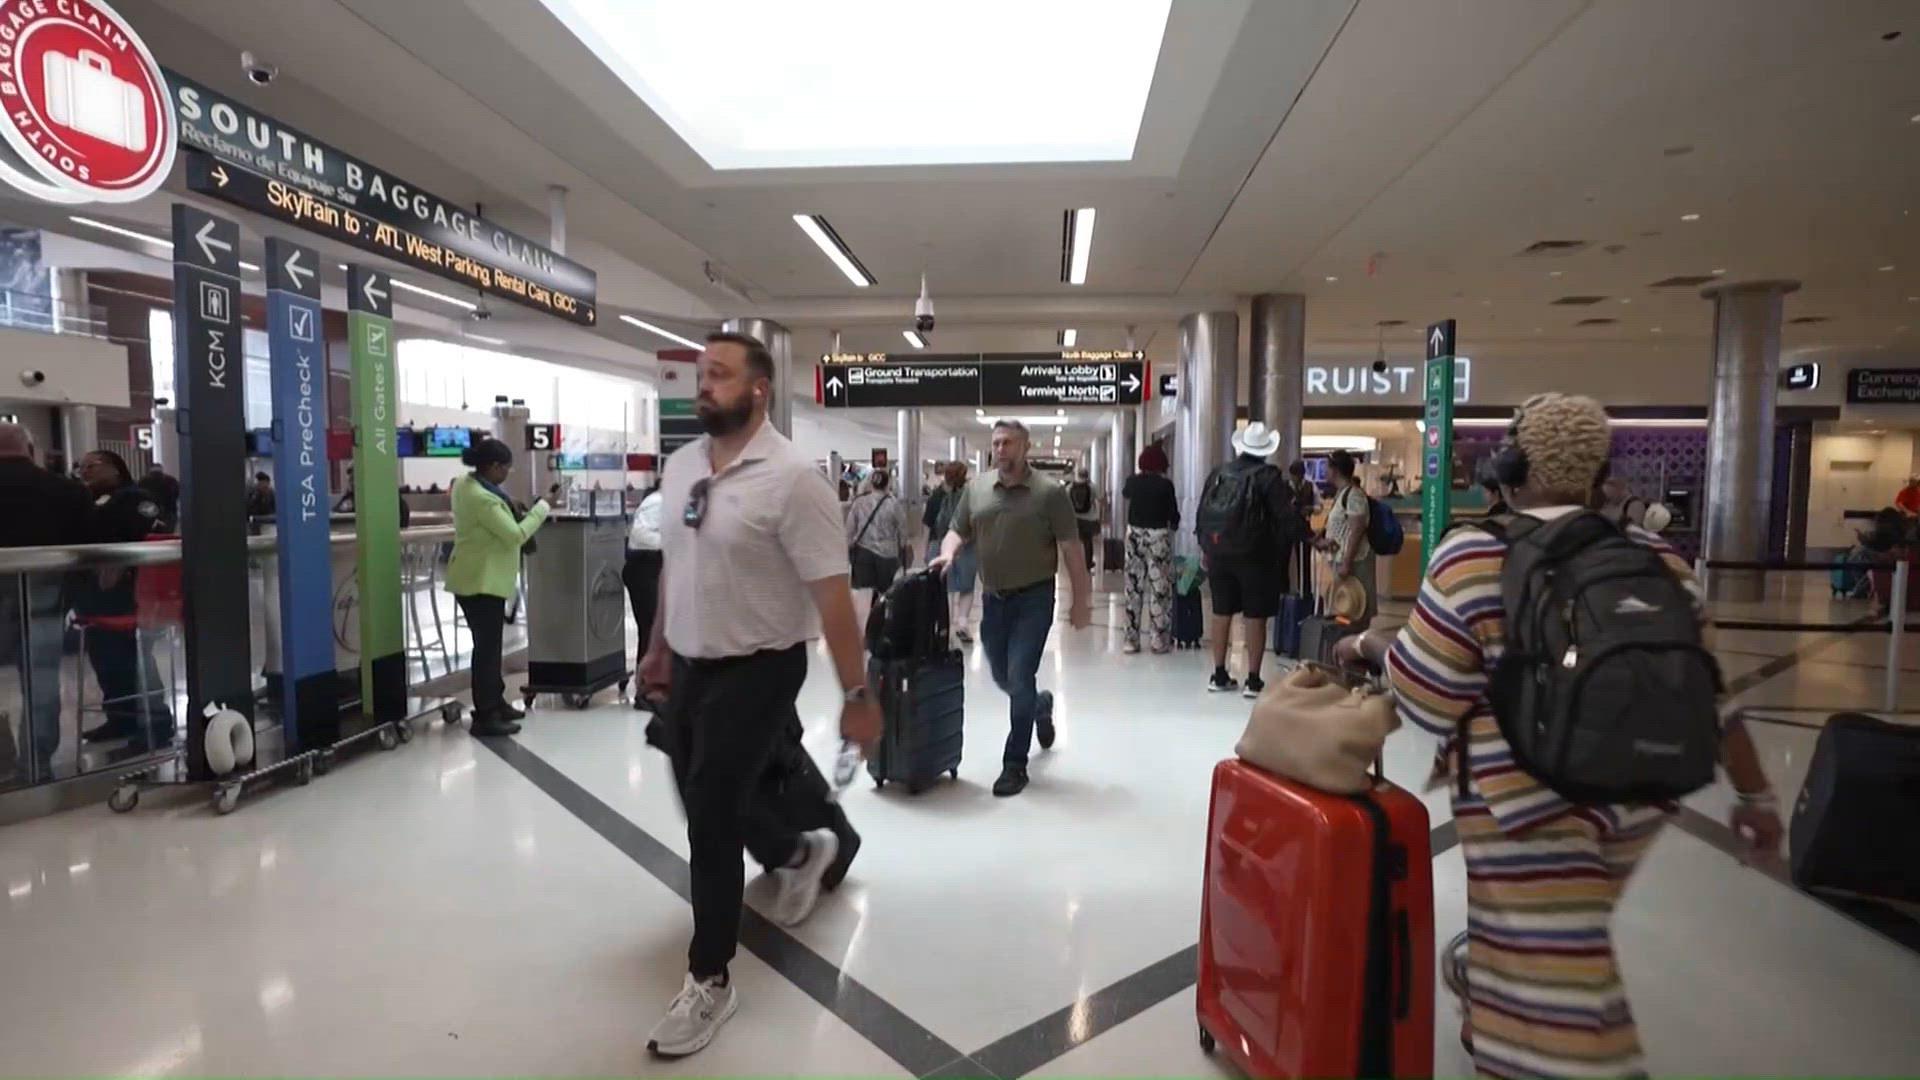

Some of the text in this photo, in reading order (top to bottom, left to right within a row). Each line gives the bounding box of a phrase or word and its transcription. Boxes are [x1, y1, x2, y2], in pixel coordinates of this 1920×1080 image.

[14, 110, 91, 181] SOUTH
[57, 0, 128, 52] CLAIM
[178, 86, 554, 275] SOUTH BAGGAGE CLAIM
[181, 120, 358, 205] Reclamo de Equipaje Sur
[267, 180, 339, 227] SkyTrain
[344, 211, 361, 235] to
[374, 225, 404, 252] ATL
[405, 233, 443, 266] West
[494, 267, 527, 296] Rental
[208, 329, 226, 389] KCM
[865, 367, 978, 379] Ground Transportation
[1021, 364, 1099, 378] Arrivals Lobby
[1307, 366, 1415, 394] RUIST
[374, 363, 387, 455] All Gates
[1020, 385, 1099, 397] Terminal North
[137, 427, 153, 450] 5
[533, 426, 549, 449] 5
[301, 475, 316, 522] TSA
